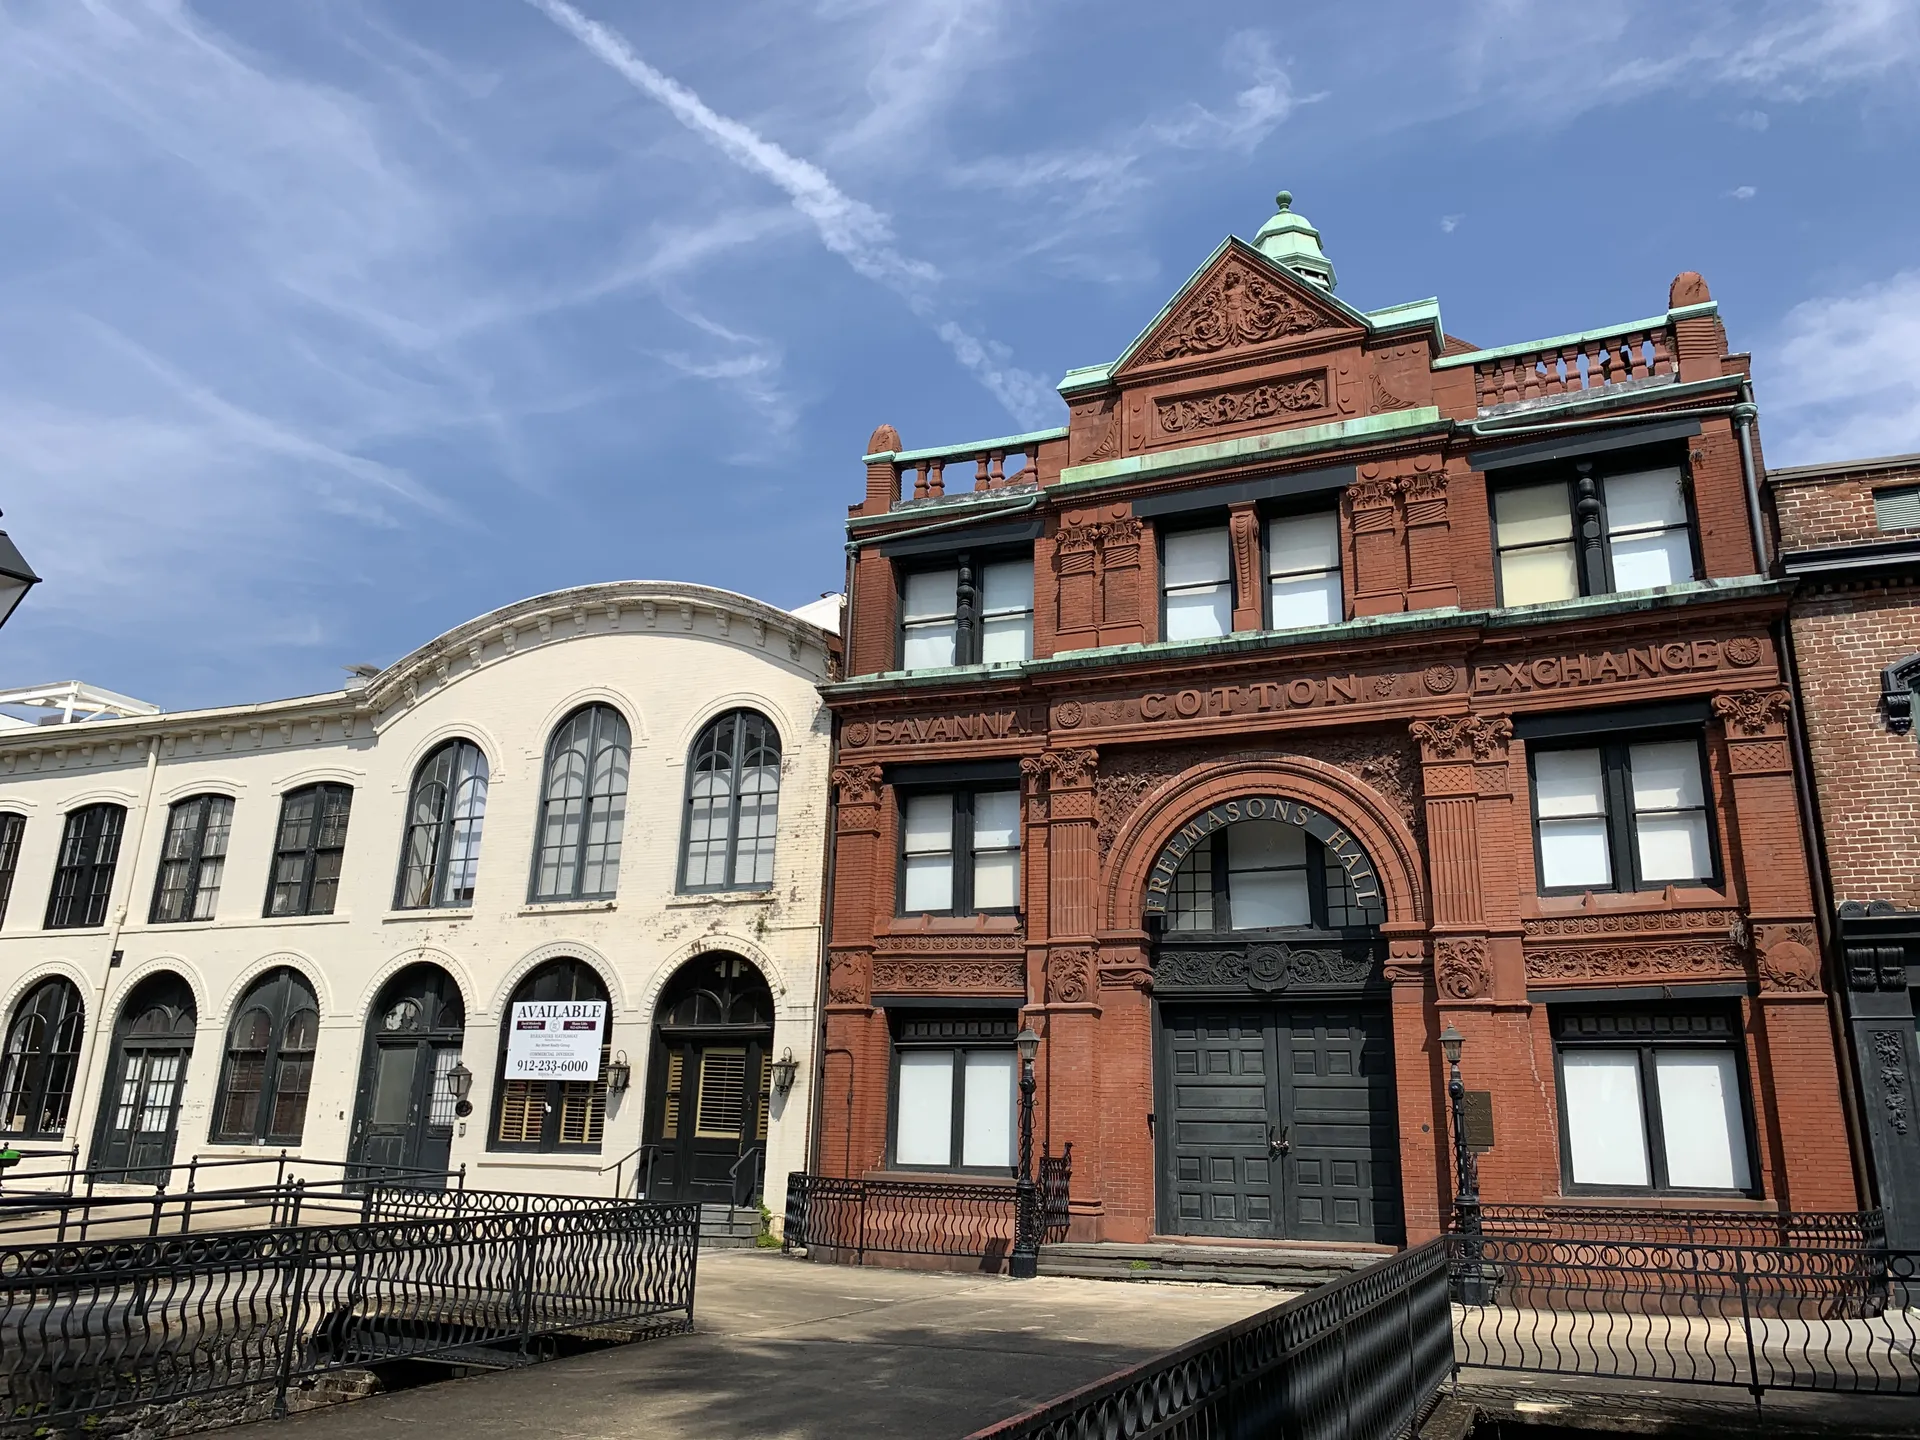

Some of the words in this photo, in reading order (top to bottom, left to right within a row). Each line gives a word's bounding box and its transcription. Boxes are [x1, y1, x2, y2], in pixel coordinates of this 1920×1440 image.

[876, 708, 1049, 744] SAVANNAH
[1140, 674, 1357, 720] COTTON
[1475, 640, 1719, 693] EXCHANGE
[1325, 828, 1378, 908] HALL
[517, 1005, 601, 1018] AVAILABLE
[517, 1060, 588, 1072] 912-233-6000
